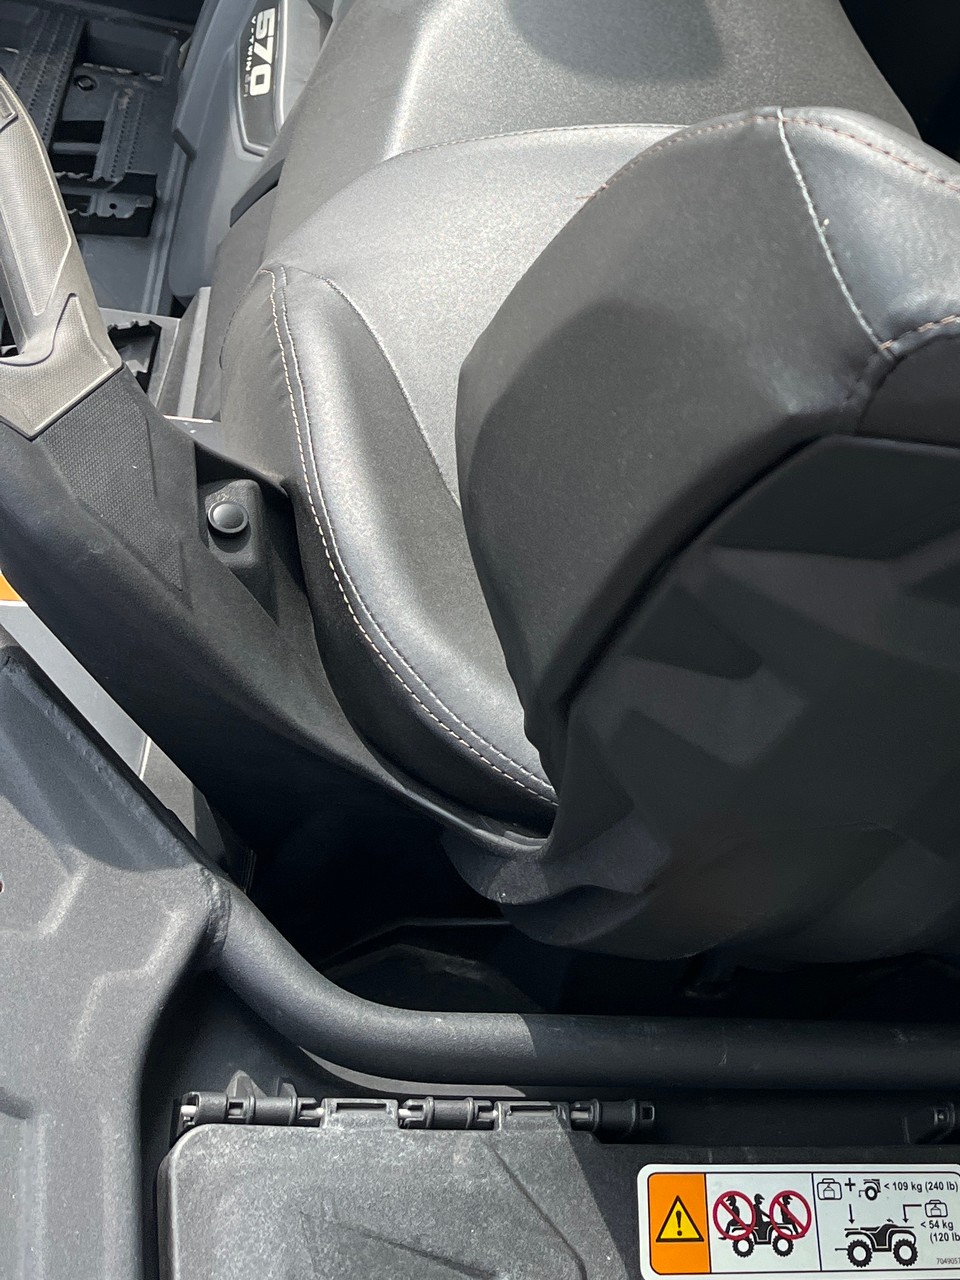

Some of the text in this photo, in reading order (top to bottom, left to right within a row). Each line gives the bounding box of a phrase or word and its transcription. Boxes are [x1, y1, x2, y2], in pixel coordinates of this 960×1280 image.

[249, 8, 276, 96] 570
[892, 1181, 909, 1191] 109
[911, 1181, 922, 1193] kg
[924, 1181, 944, 1193] (240
[946, 1181, 959, 1193] lb)
[928, 1220, 940, 1229] 54
[942, 1219, 954, 1231] kg
[929, 1232, 950, 1244] (120
